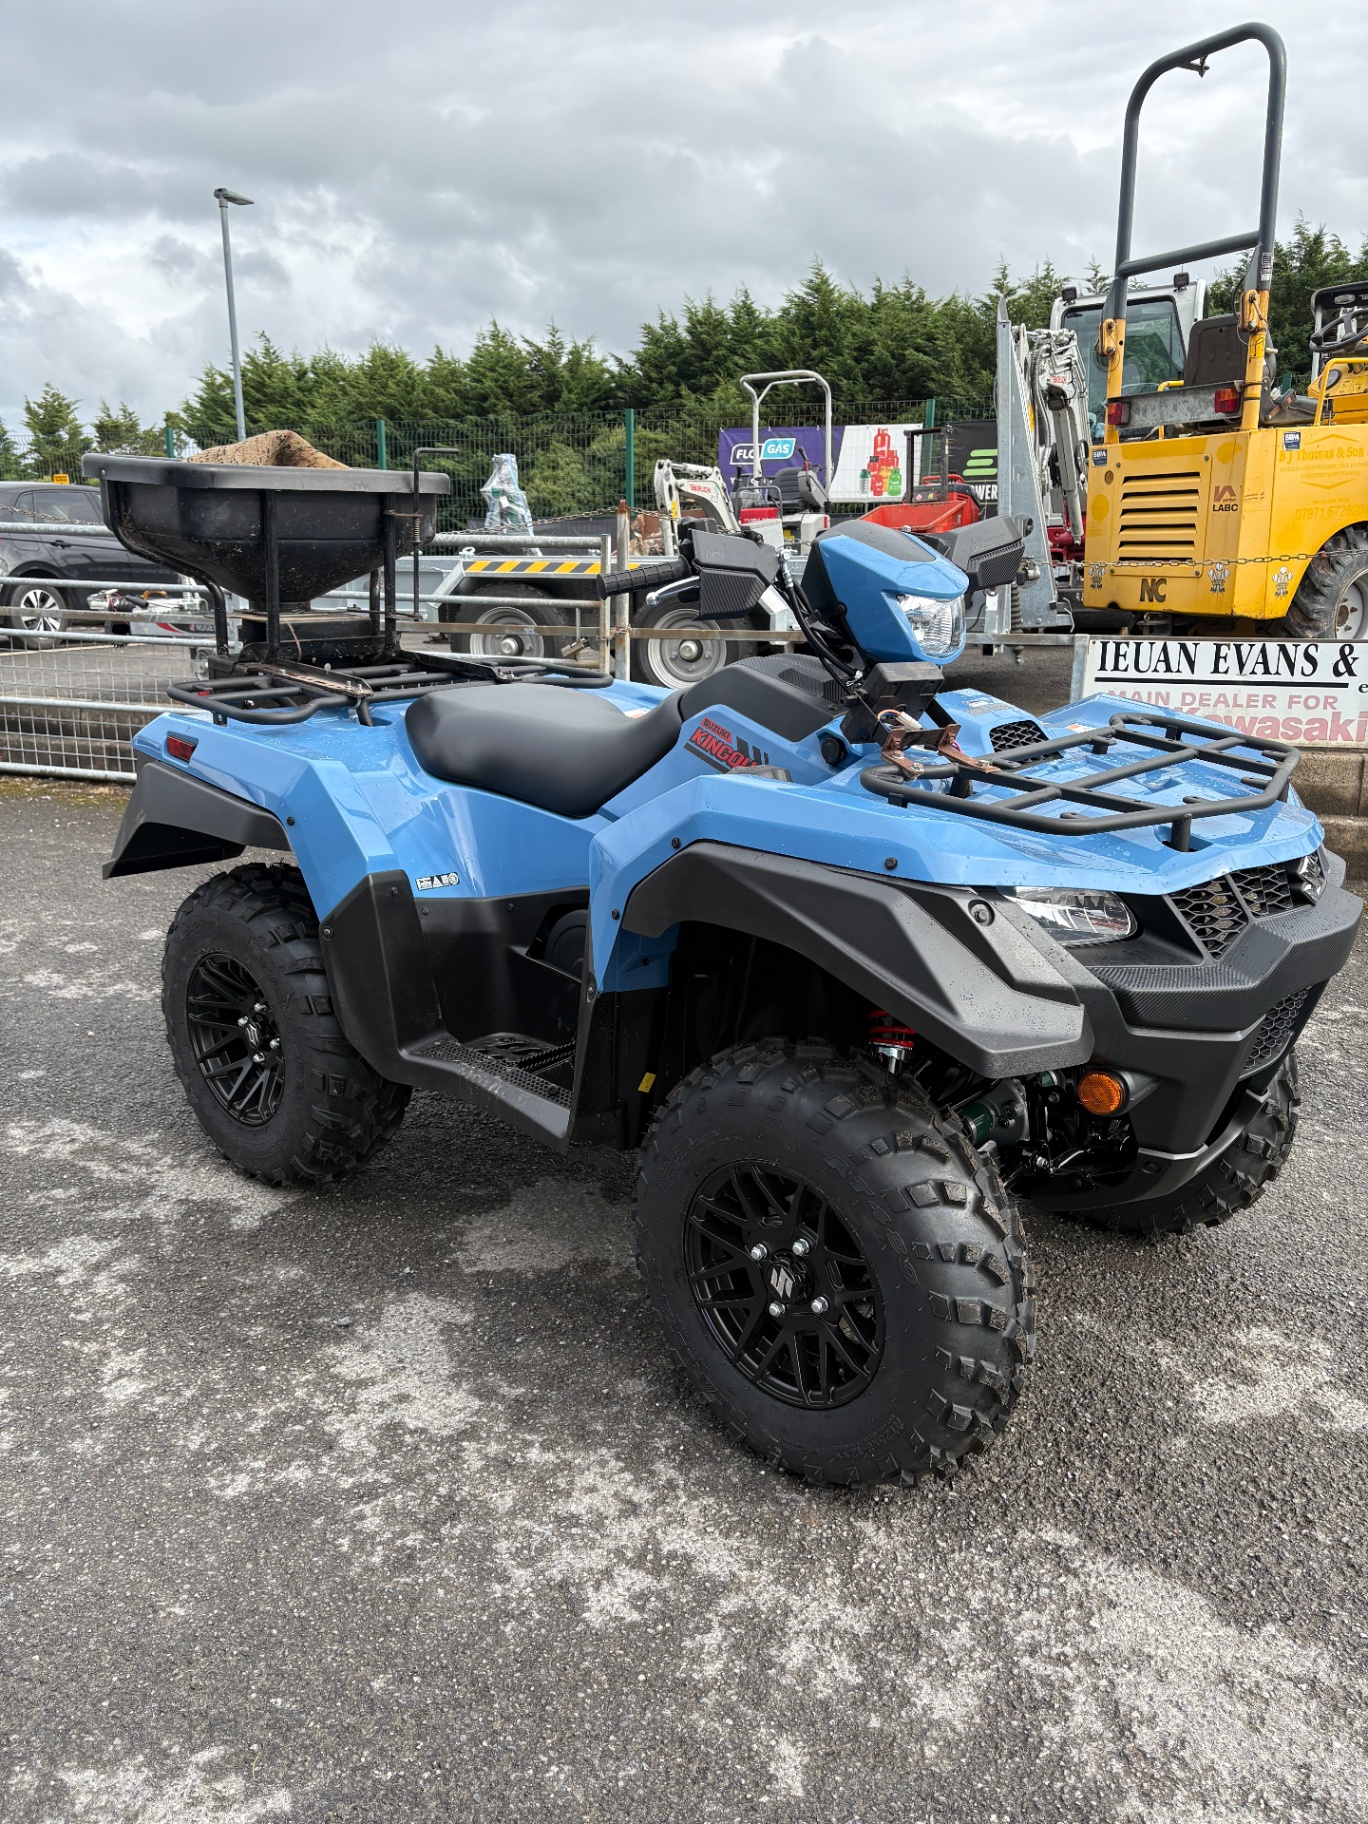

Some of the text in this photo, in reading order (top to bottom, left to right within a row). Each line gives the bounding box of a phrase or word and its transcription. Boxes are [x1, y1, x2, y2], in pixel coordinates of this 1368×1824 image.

[767, 444, 790, 454] GAS
[1296, 448, 1335, 461] Thomas
[1336, 446, 1345, 458] &
[1347, 446, 1364, 458] Son
[1212, 503, 1239, 512] LABC
[1139, 577, 1167, 603] NC
[1097, 640, 1360, 678] IEUAN EVANS &
[1180, 692, 1277, 709] DEALER
[1287, 694, 1339, 711] FOR
[702, 719, 731, 741] SUZUKI
